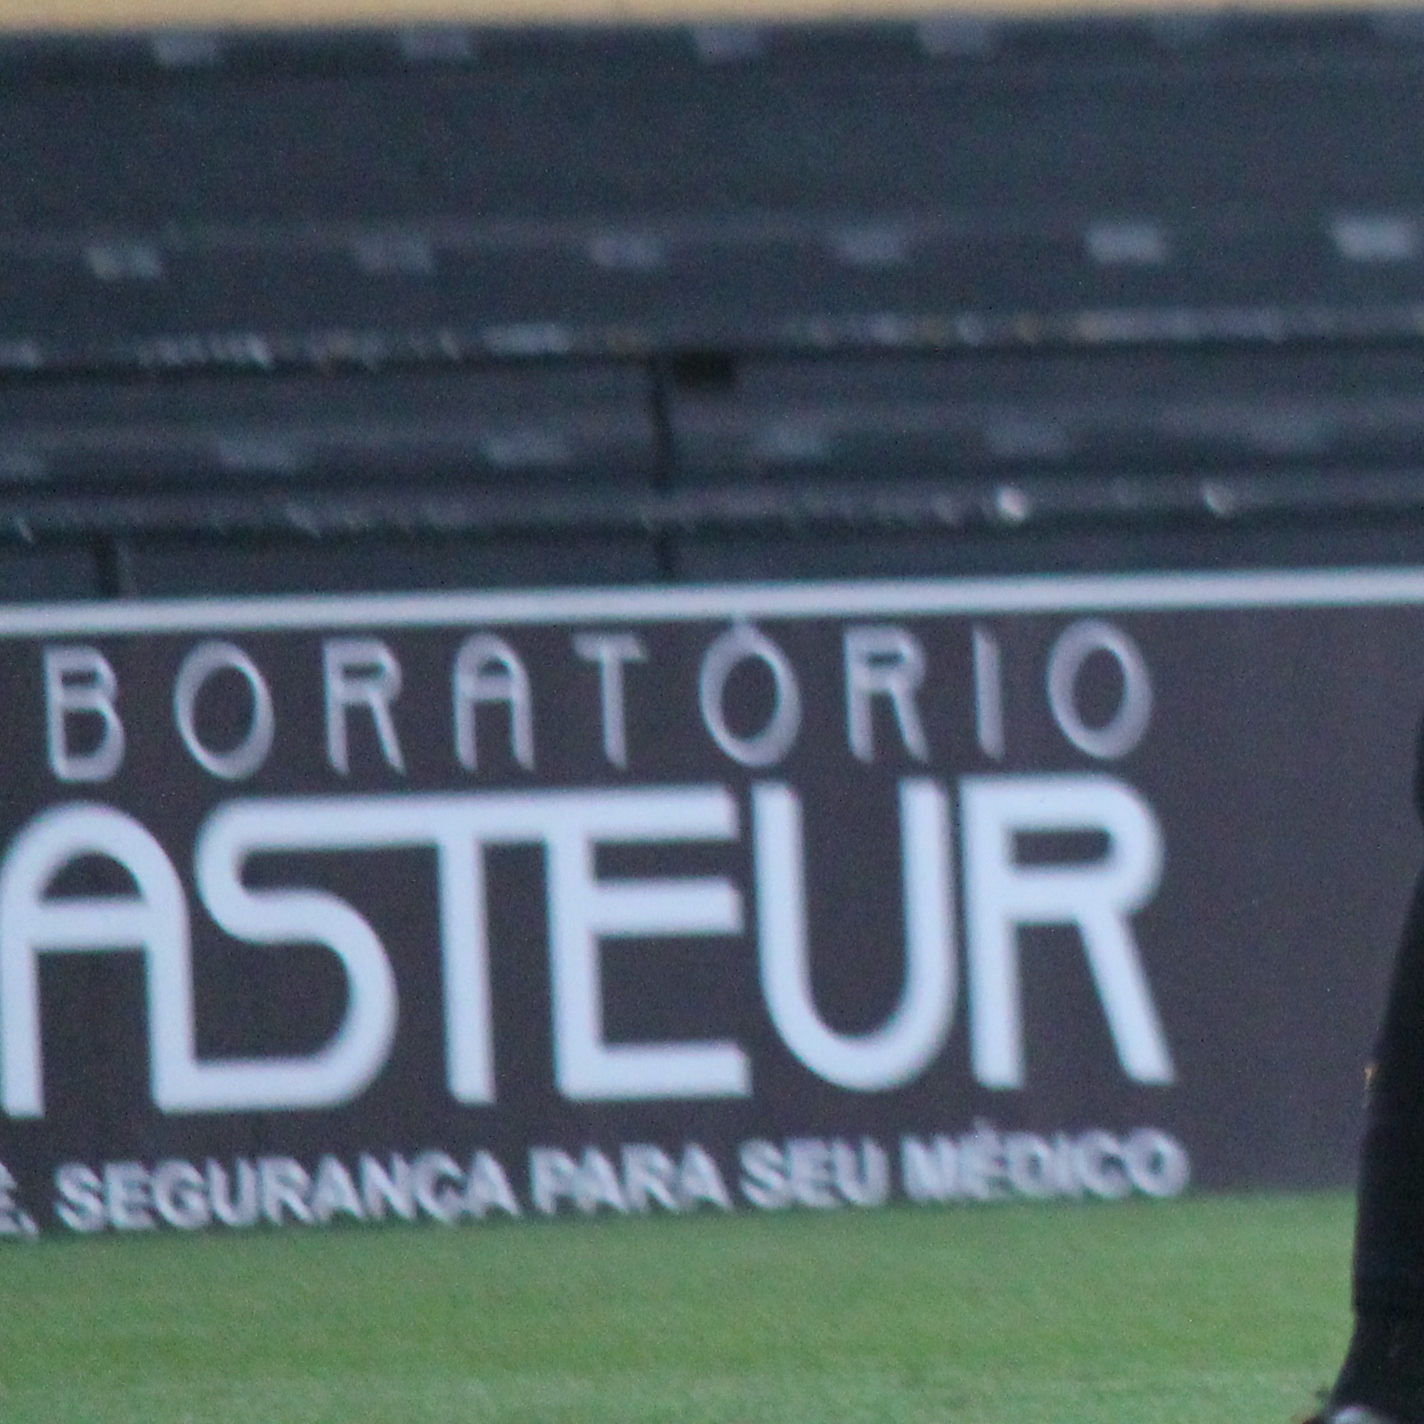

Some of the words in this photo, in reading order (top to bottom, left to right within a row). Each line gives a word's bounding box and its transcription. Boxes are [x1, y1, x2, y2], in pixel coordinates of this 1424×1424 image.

[528, 1142, 735, 1216] PARA
[738, 1136, 890, 1210] SEU
[900, 1116, 1192, 1202] MÉDICO
